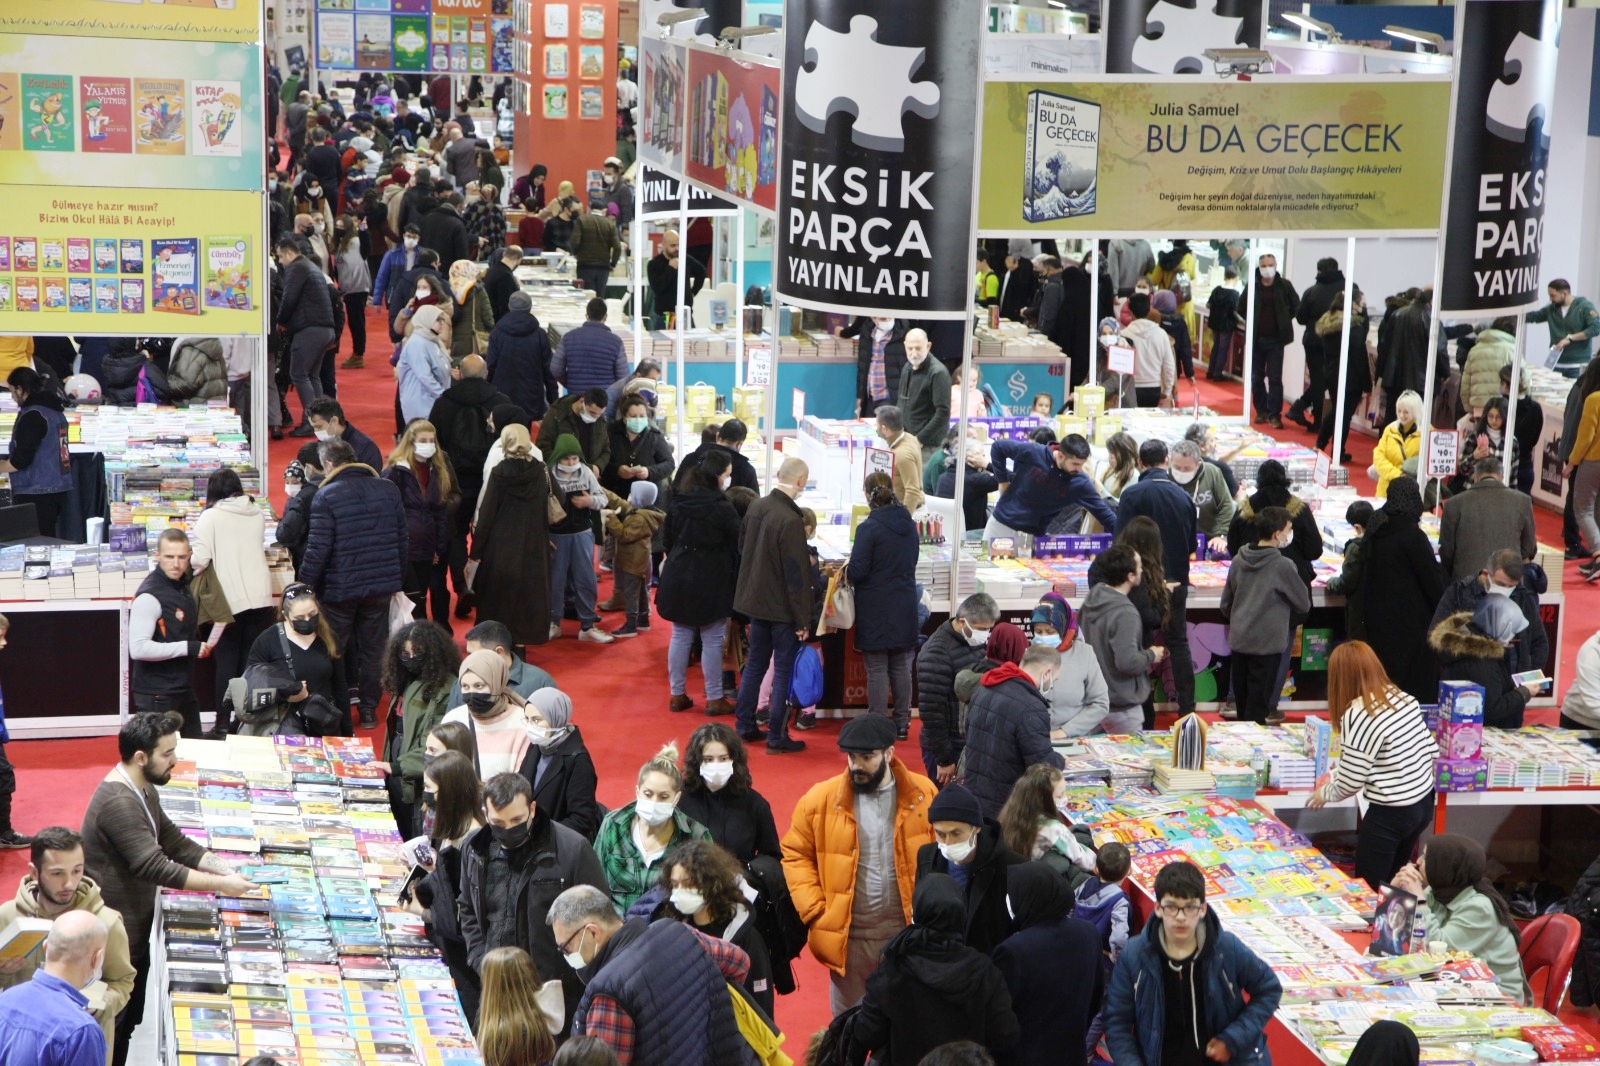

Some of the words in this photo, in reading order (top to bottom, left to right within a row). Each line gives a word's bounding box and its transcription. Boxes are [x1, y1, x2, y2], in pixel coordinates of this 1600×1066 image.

[1040, 100, 1055, 108] Julia
[1056, 102, 1075, 112] Samuel
[1150, 102, 1183, 116] Julia
[1188, 103, 1239, 116] Samuel
[1040, 110, 1057, 124] BU
[1060, 114, 1077, 127] DA
[1046, 126, 1097, 143] GEÇECEK
[1147, 124, 1188, 153] BU
[1200, 124, 1246, 153] DA
[1256, 124, 1403, 159] GEÇECEK
[1188, 166, 1226, 176] Değişim,
[1230, 166, 1246, 174] Kriz
[1262, 166, 1285, 174] Umut
[1288, 165, 1308, 174] Dolu
[1311, 165, 1354, 176] Başlangıç
[1160, 193, 1191, 202] Değişim
[1208, 193, 1228, 202] şeyin
[1231, 193, 1251, 202] doğal
[1254, 192, 1294, 201] düzeniyse,
[1478, 169, 1548, 212] EKS
[52, 200, 93, 211] Gülmeye
[97, 201, 124, 211] hazır
[1177, 203, 1205, 211] devasa
[1207, 203, 1233, 211] dönüm
[1322, 203, 1359, 212] ediyoruz?
[39, 214, 68, 223] Bizim
[73, 214, 95, 224] Okul
[124, 216, 133, 225] Bi
[137, 216, 175, 227] Acayip!
[789, 207, 932, 264] PARÇA
[788, 256, 929, 298] YAYINLARI
[1048, 365, 1064, 376] 413
